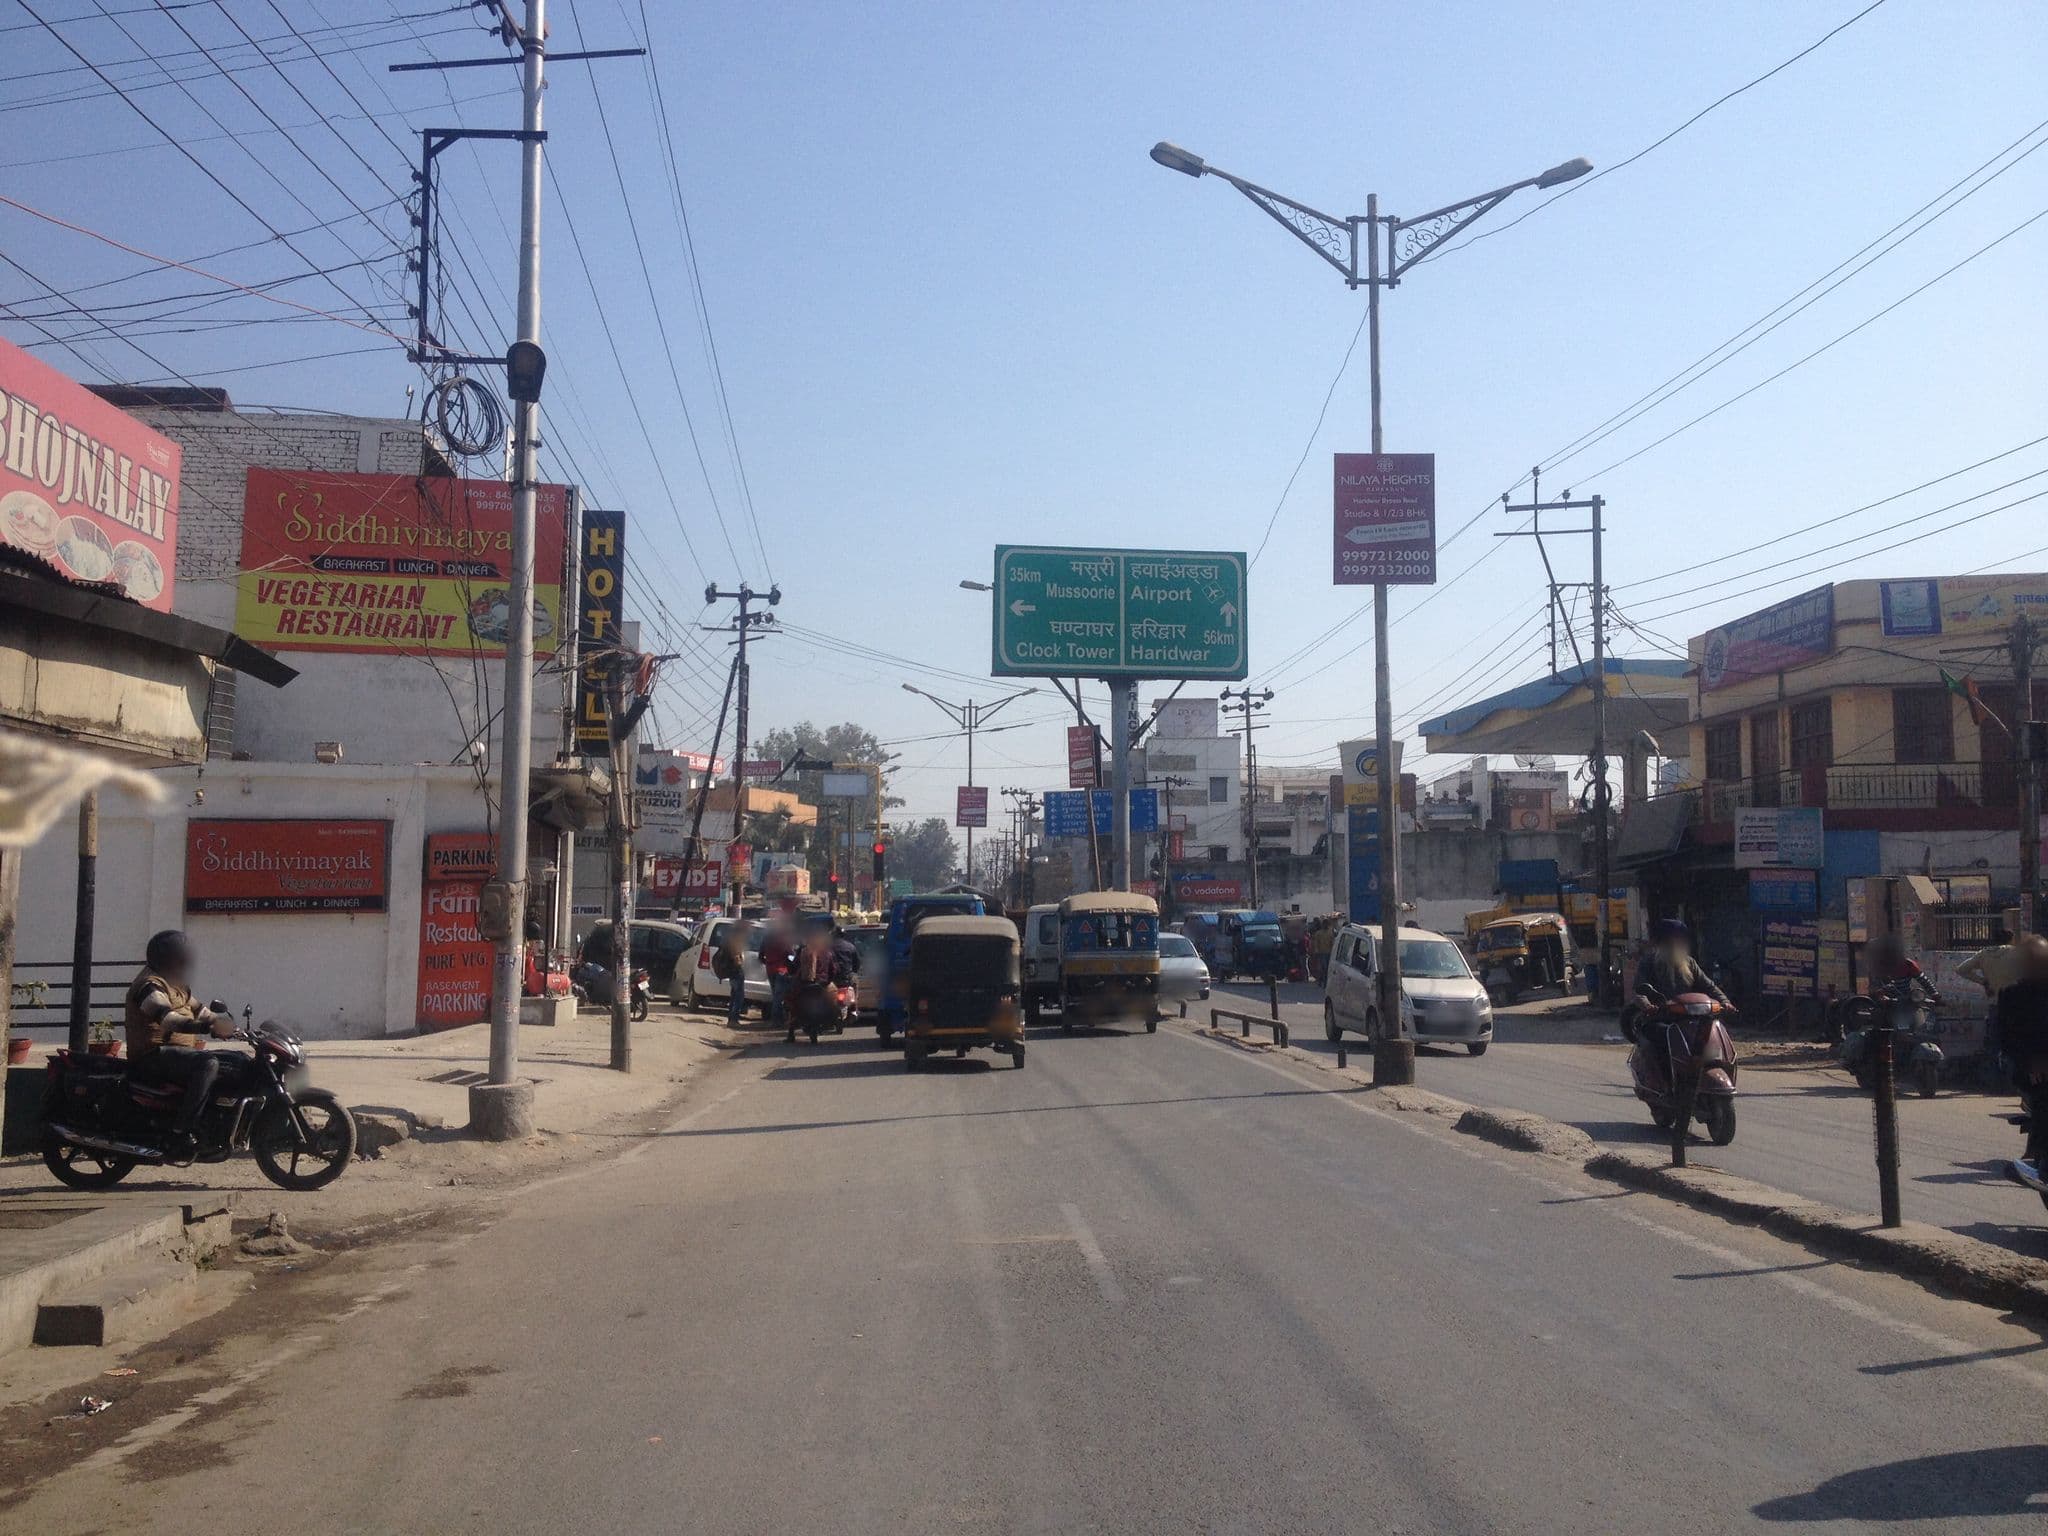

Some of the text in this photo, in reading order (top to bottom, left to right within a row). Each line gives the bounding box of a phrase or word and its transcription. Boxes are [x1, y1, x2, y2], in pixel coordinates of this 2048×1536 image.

[1341, 474, 1431, 485] NILAYA HEIGHTS
[477, 500, 513, 511] 999700
[1344, 509, 1371, 518] Studio
[1383, 509, 1404, 518] 1/2/3
[1407, 507, 1426, 517] BHK
[285, 502, 513, 556] Siddhivinaya
[1343, 550, 1430, 561] 9997212000
[323, 558, 488, 576] BREAKFAST LUNCH DINNER
[1010, 567, 1041, 582] 35km
[1070, 556, 1115, 582] मसूरी
[1343, 565, 1431, 575] 9997332000
[258, 579, 426, 610] VEGETARIAN
[1046, 582, 1116, 599] Mussoorie
[1131, 585, 1192, 604] Airport
[276, 609, 457, 640] RESTAURANT
[1049, 621, 1115, 637] घण्टाघर
[1130, 617, 1186, 639] हरिद्वार
[1203, 629, 1235, 645] 56km
[1016, 641, 1115, 659] Clock Tower
[1131, 645, 1210, 661] Haridwar
[635, 789, 682, 798] MARUTI
[203, 846, 372, 873] Siddhivinayak
[656, 869, 719, 887] EXIDE
[1194, 886, 1235, 896] vodafone
[205, 898, 360, 910] BREAKFAST LUNCH DINNER
[428, 888, 481, 916] Fam
[426, 954, 455, 969] PURE
[426, 981, 480, 991] BASEMENT
[423, 993, 488, 1012] PARKING
